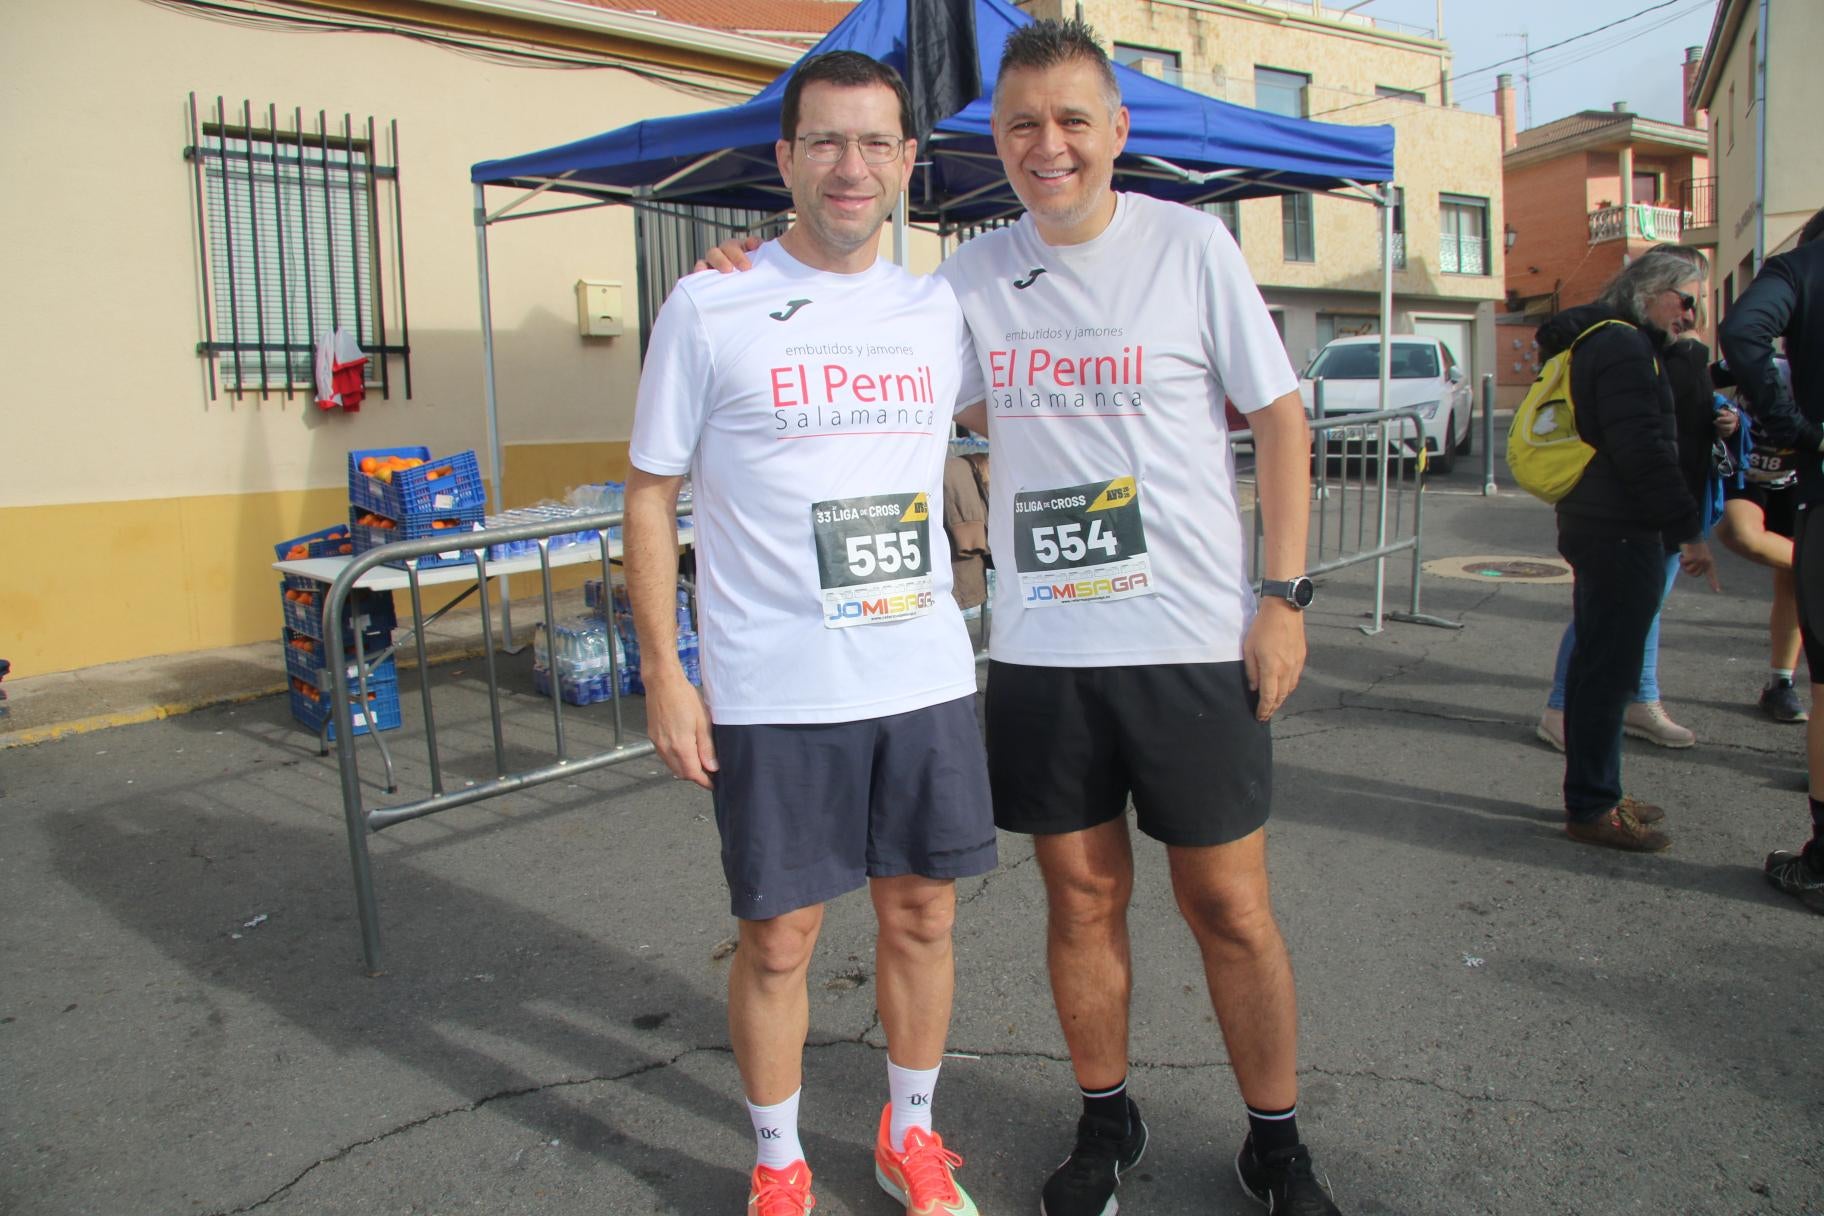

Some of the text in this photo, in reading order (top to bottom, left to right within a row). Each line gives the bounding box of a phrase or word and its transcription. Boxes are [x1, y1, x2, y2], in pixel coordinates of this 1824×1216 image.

[1005, 327, 1123, 342] embutidos y jamones
[785, 342, 914, 357] embutidos y jamones
[989, 345, 1143, 388] El Pernil
[770, 364, 935, 408] El Pernil
[992, 388, 1142, 409] Salamanca
[774, 405, 934, 430] Salamanca
[832, 508, 859, 522] LIGA
[869, 504, 901, 516] CROSS
[1024, 501, 1043, 513] LIGA
[1051, 494, 1086, 510] CROSS
[845, 530, 921, 577] 555
[1032, 519, 1118, 564] 554
[1027, 572, 1149, 601] JOMISAGA
